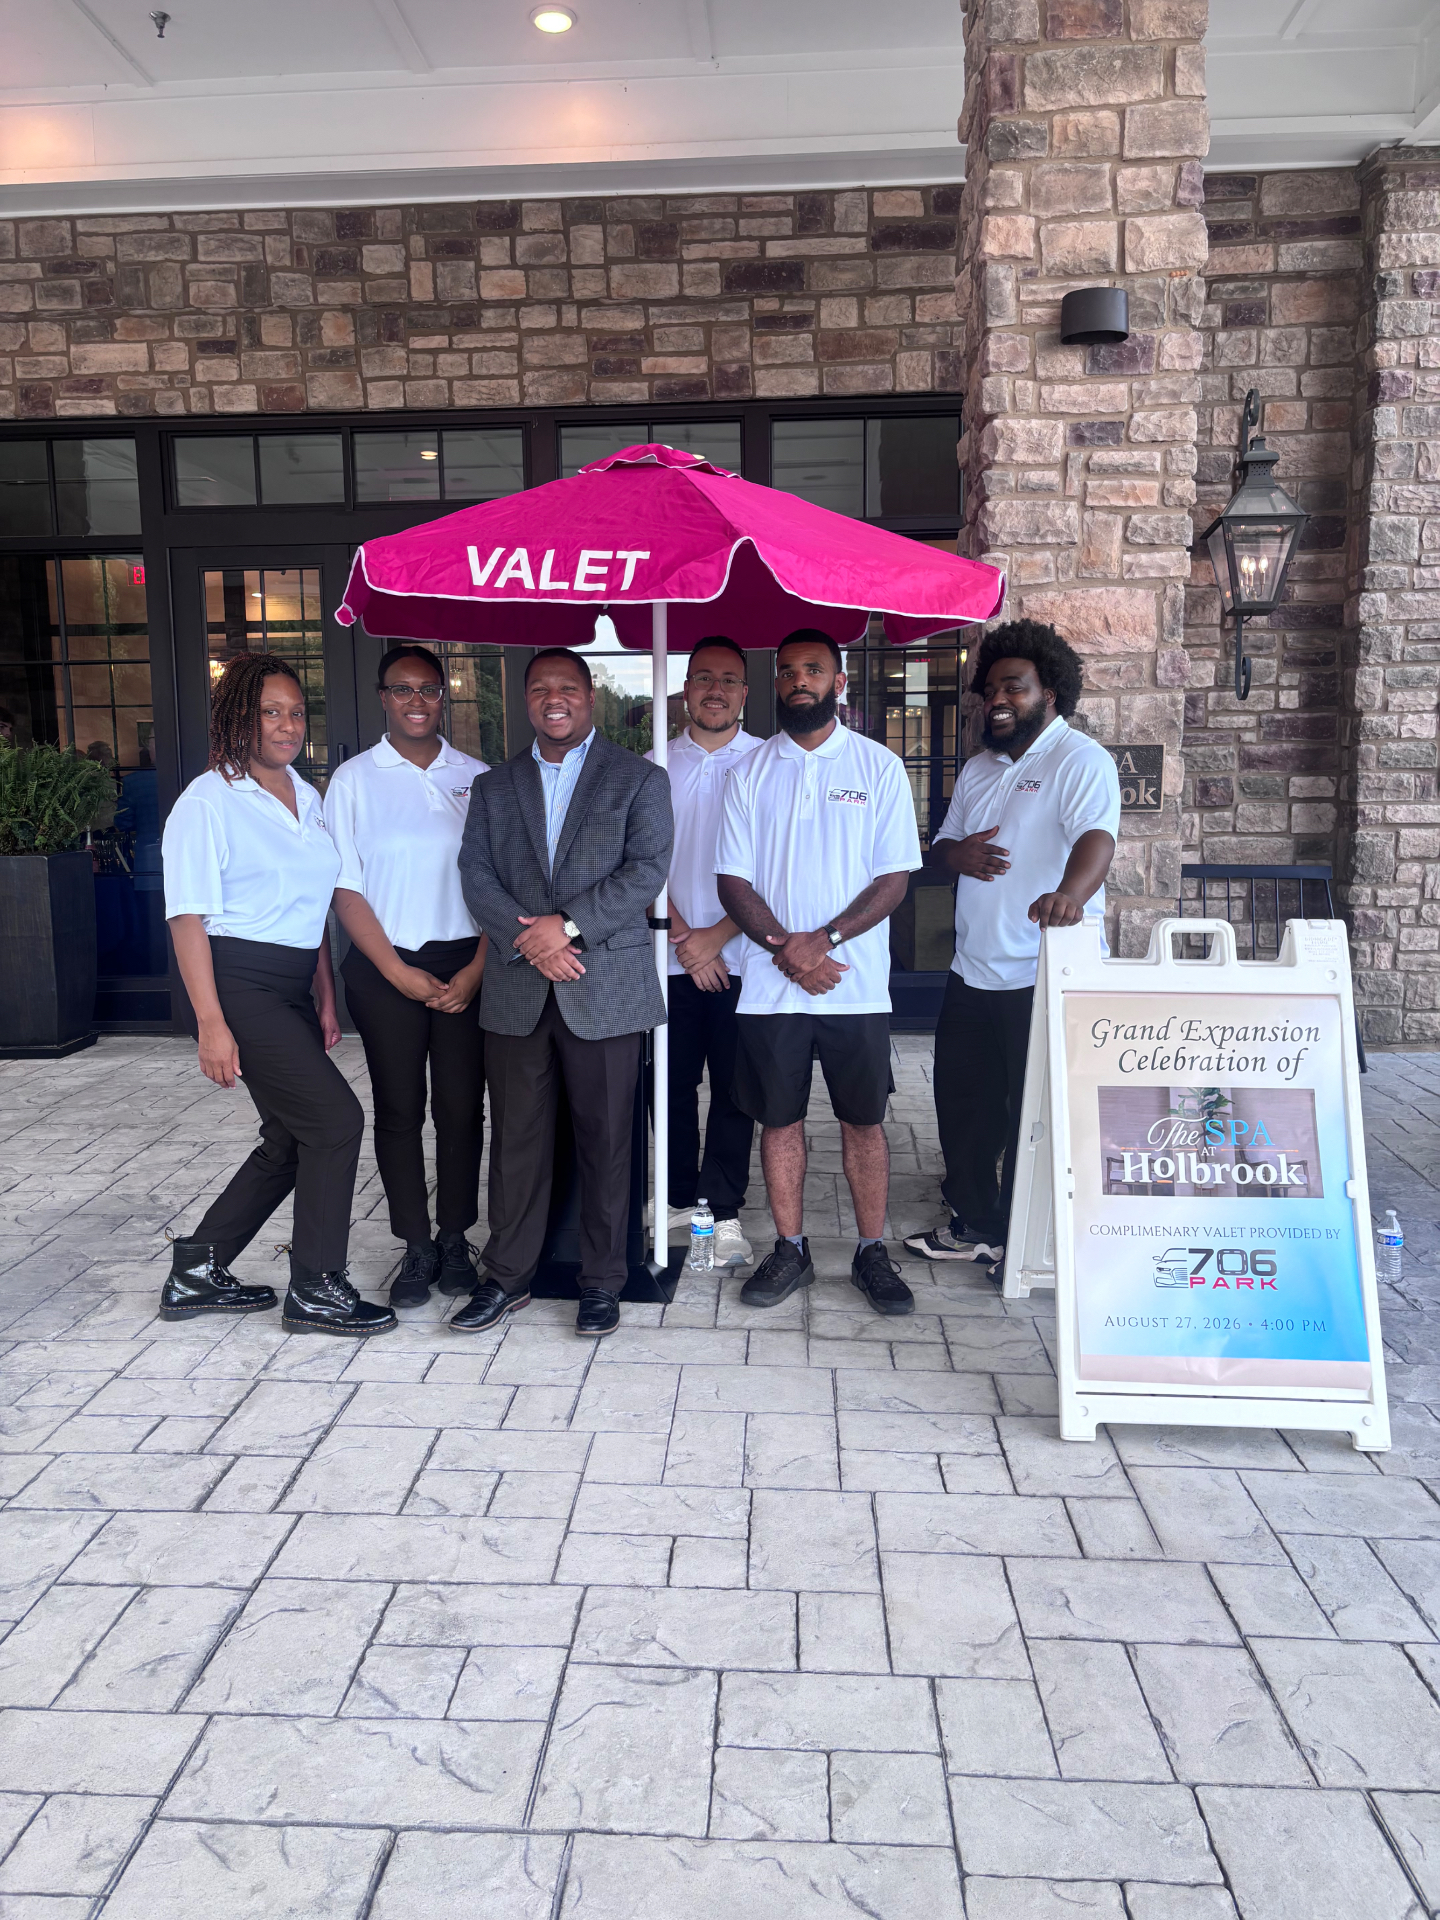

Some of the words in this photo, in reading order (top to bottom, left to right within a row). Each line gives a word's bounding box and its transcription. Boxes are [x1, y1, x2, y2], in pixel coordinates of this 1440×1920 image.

[467, 545, 651, 592] VALET
[1022, 780, 1042, 789] 706
[839, 797, 866, 805] PARK
[840, 789, 868, 801] 706
[1091, 1015, 1177, 1049] Grand
[1180, 1018, 1321, 1050] Expansion
[1118, 1046, 1268, 1074] Celebration
[1276, 1047, 1310, 1081] of
[1147, 1116, 1208, 1152] The
[1205, 1119, 1276, 1147] SPA
[1201, 1146, 1217, 1157] AT
[1120, 1151, 1305, 1186] Holbrook
[1089, 1224, 1200, 1238] COMPLIMENARY
[1203, 1225, 1246, 1239] VALET
[1249, 1226, 1323, 1240] PROVIDED
[1325, 1228, 1342, 1241] BY
[1187, 1248, 1277, 1277] 706
[1189, 1277, 1279, 1291] PARK
[1104, 1315, 1168, 1329] AUGUST
[1203, 1316, 1242, 1331] 2026
[1260, 1318, 1295, 1332] 4:00
[1302, 1319, 1327, 1333] PM
